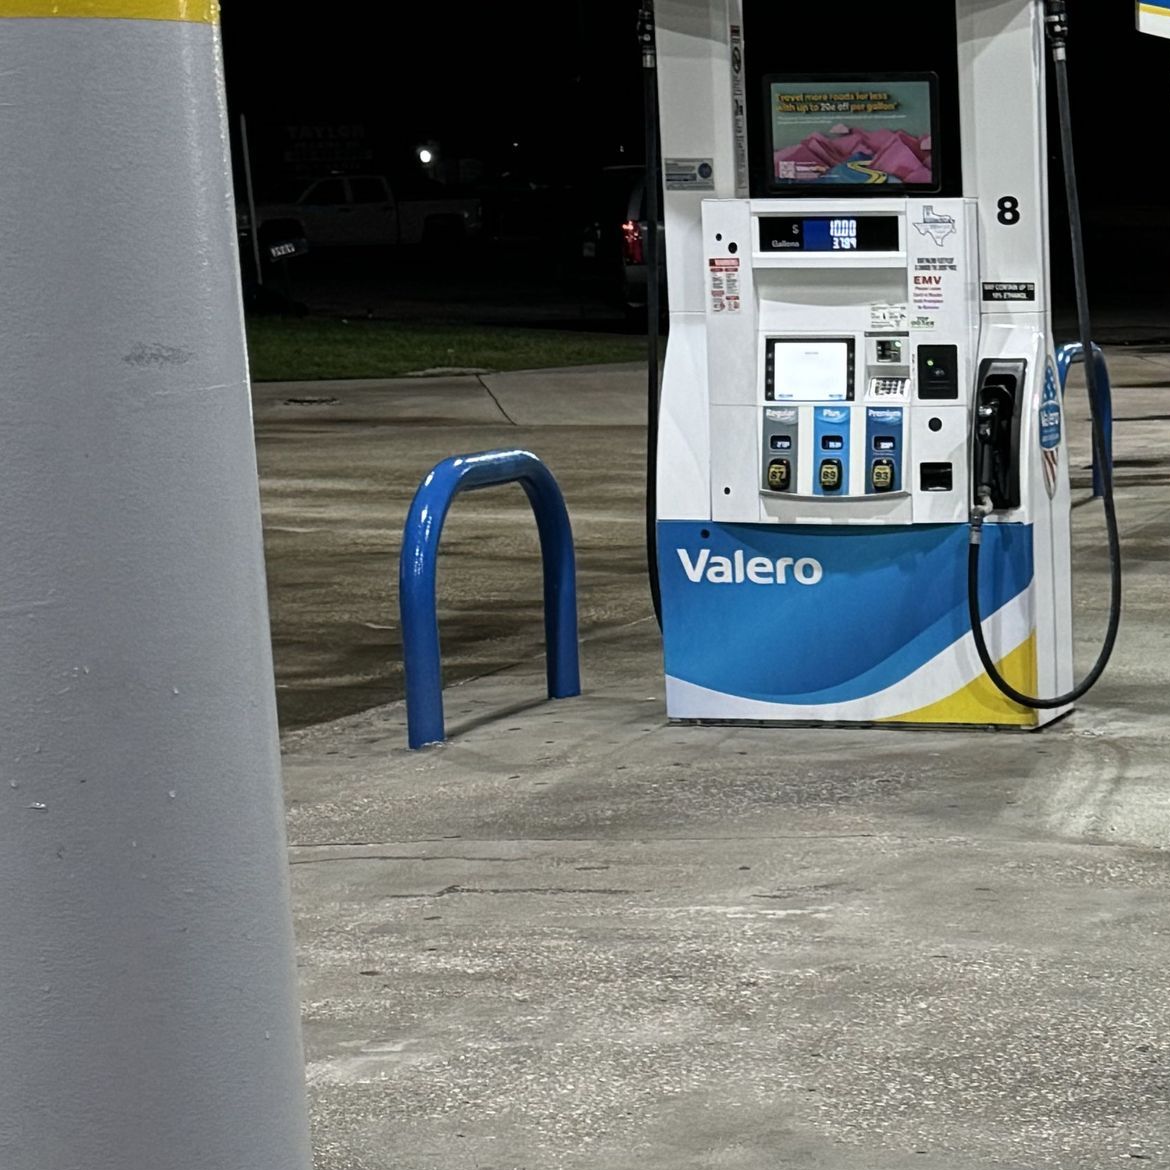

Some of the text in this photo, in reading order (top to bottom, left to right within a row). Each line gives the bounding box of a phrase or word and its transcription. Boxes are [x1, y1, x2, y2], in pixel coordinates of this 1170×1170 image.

[997, 196, 1020, 225] 8
[913, 276, 942, 285] EMV
[766, 408, 795, 418] Regular
[823, 408, 840, 417] Plus
[868, 408, 901, 417] Premium
[770, 471, 784, 480] 87
[875, 471, 889, 480] 93
[676, 548, 823, 585] Valero
